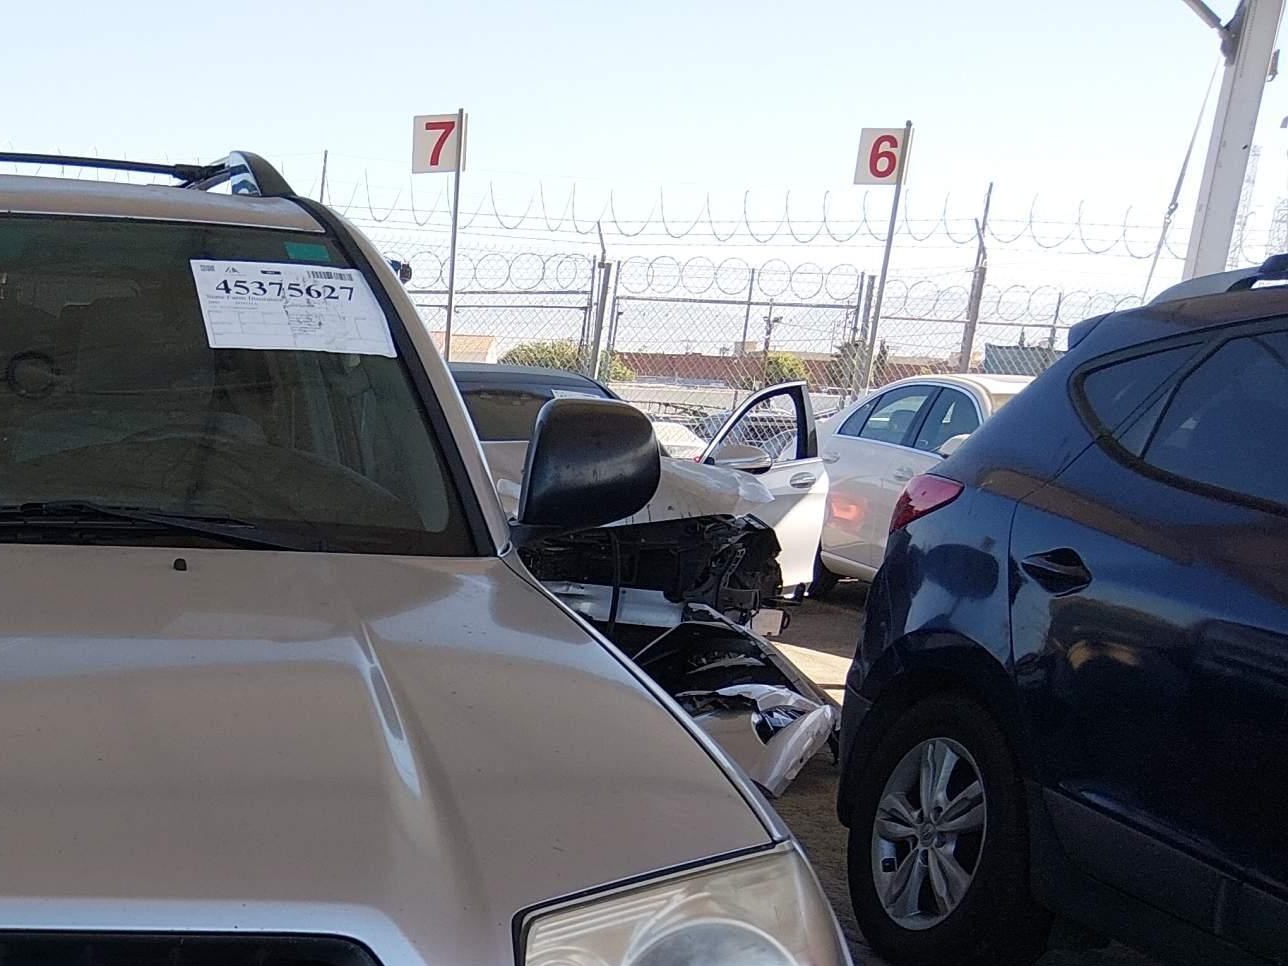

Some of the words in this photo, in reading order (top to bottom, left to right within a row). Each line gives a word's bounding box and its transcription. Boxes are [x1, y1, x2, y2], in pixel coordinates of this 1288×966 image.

[425, 121, 456, 166] 7
[869, 135, 898, 177] 6
[216, 279, 354, 301] 45375627
